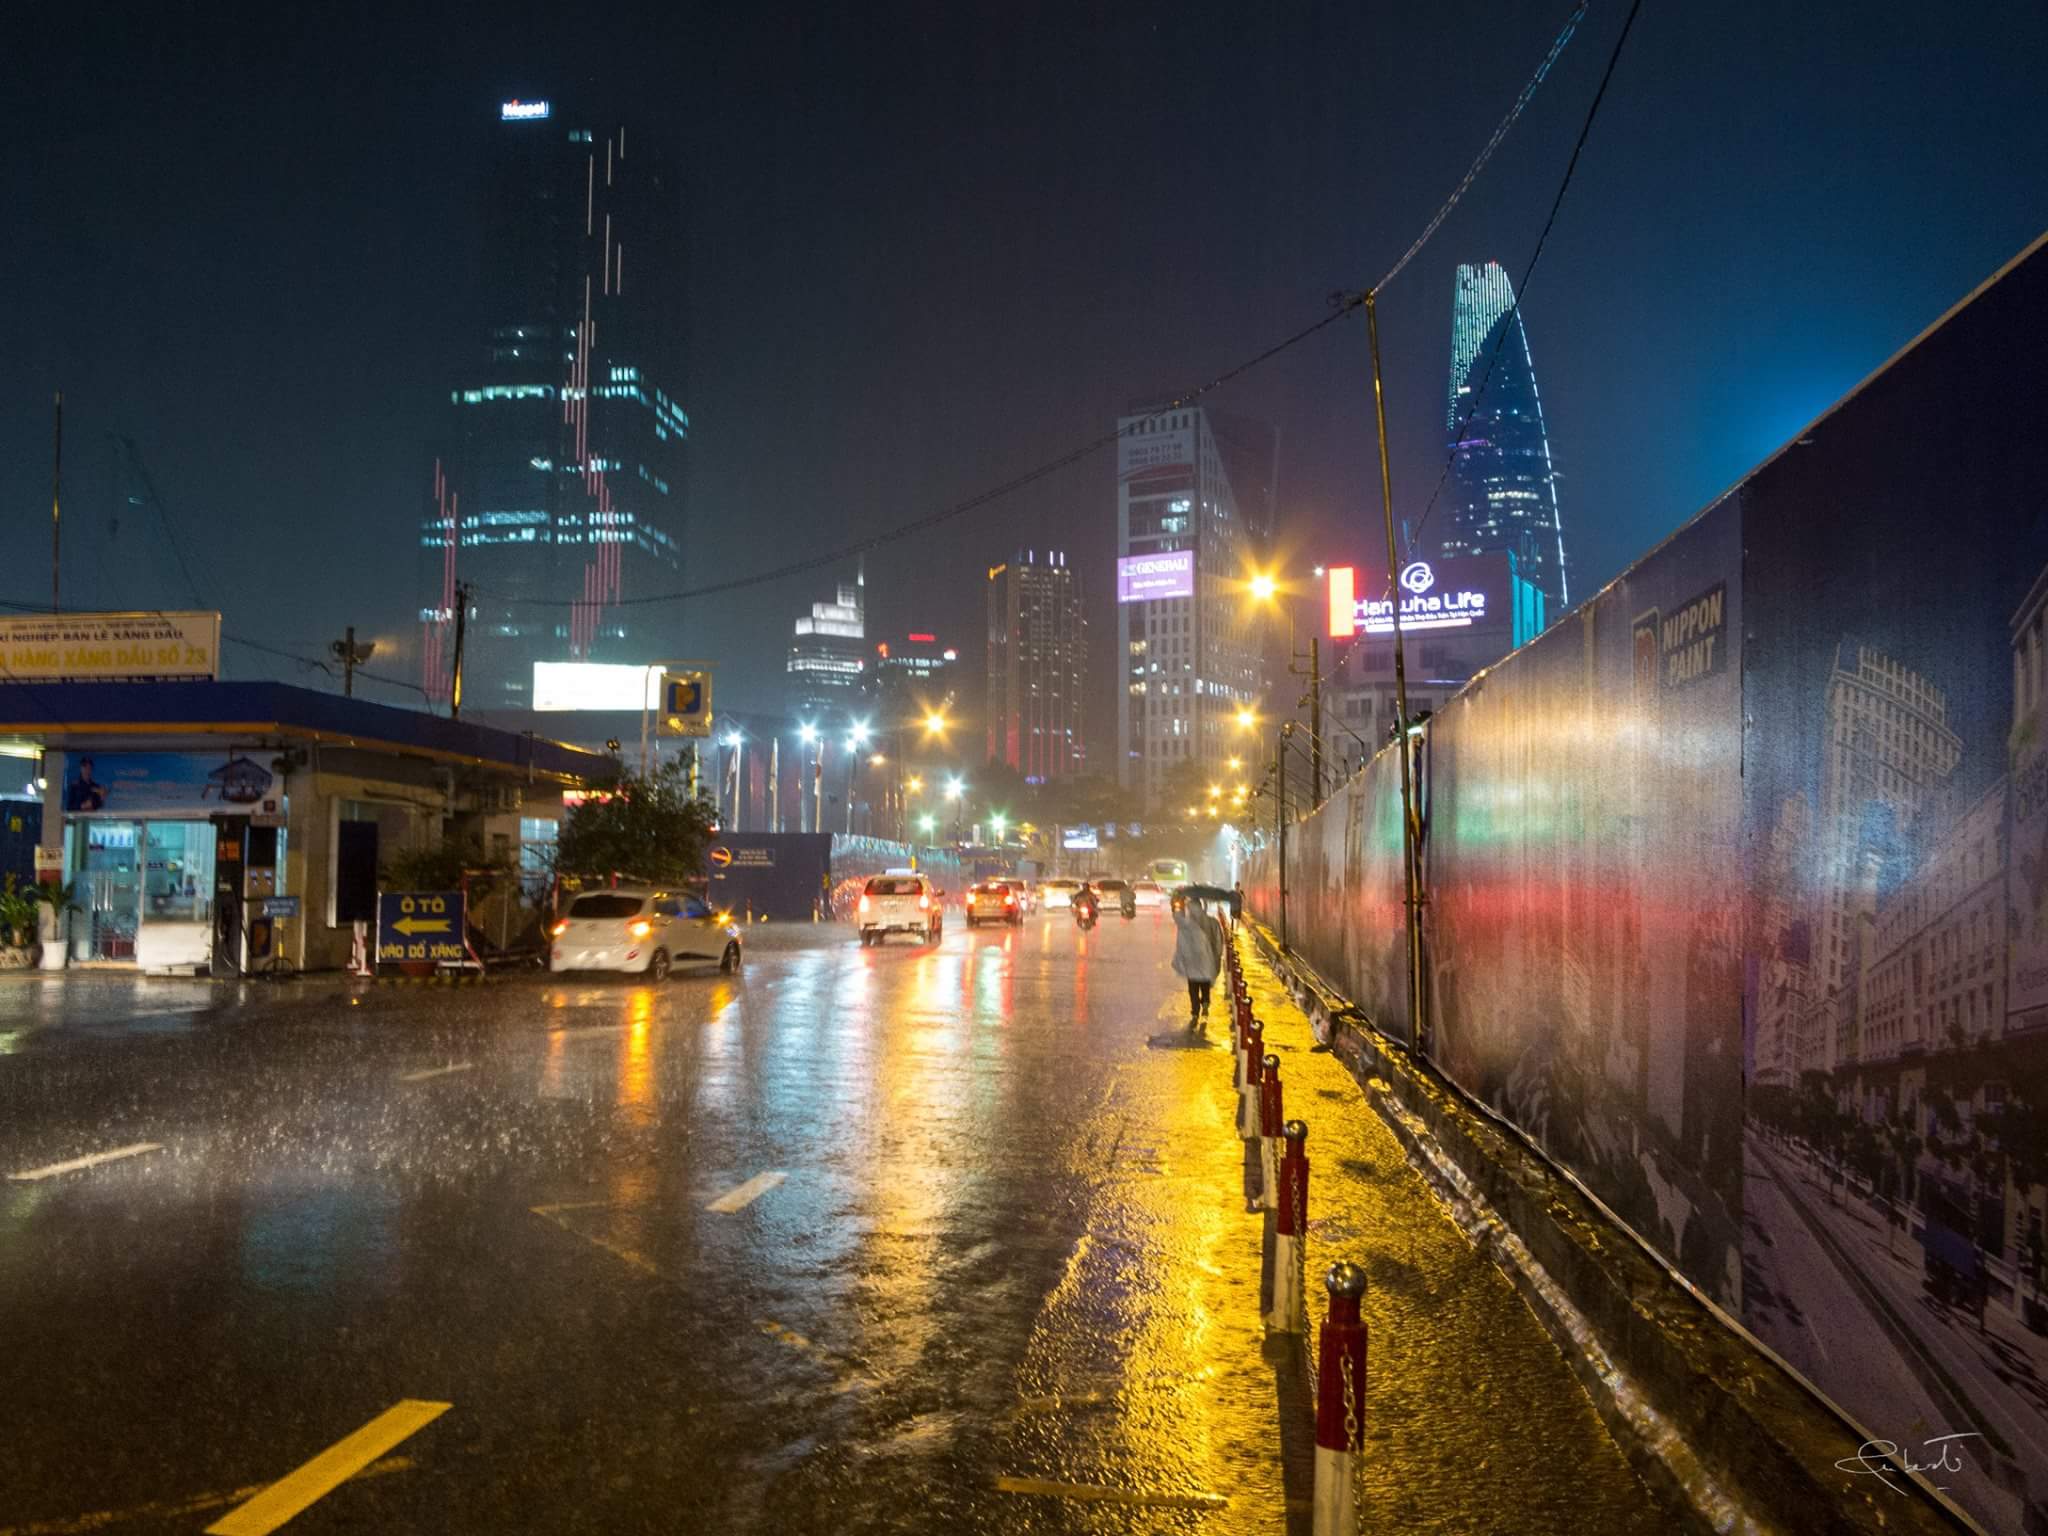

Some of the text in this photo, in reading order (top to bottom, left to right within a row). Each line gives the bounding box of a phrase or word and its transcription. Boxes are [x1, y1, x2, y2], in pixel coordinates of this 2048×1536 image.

[1444, 592, 1485, 609] Life
[1663, 589, 1723, 651] NIPPON
[12, 630, 60, 643] NGHIỆP
[112, 627, 151, 641] XĂNG
[154, 626, 184, 640] DẦU
[12, 647, 59, 668] HÀNG
[64, 645, 113, 668] XĂNG
[117, 642, 153, 666] DẦU
[158, 642, 180, 665] SỐ
[184, 647, 207, 665] 23
[1670, 634, 1716, 687] PAINT
[380, 941, 404, 960] VÀO
[430, 940, 462, 960] XĂNG
